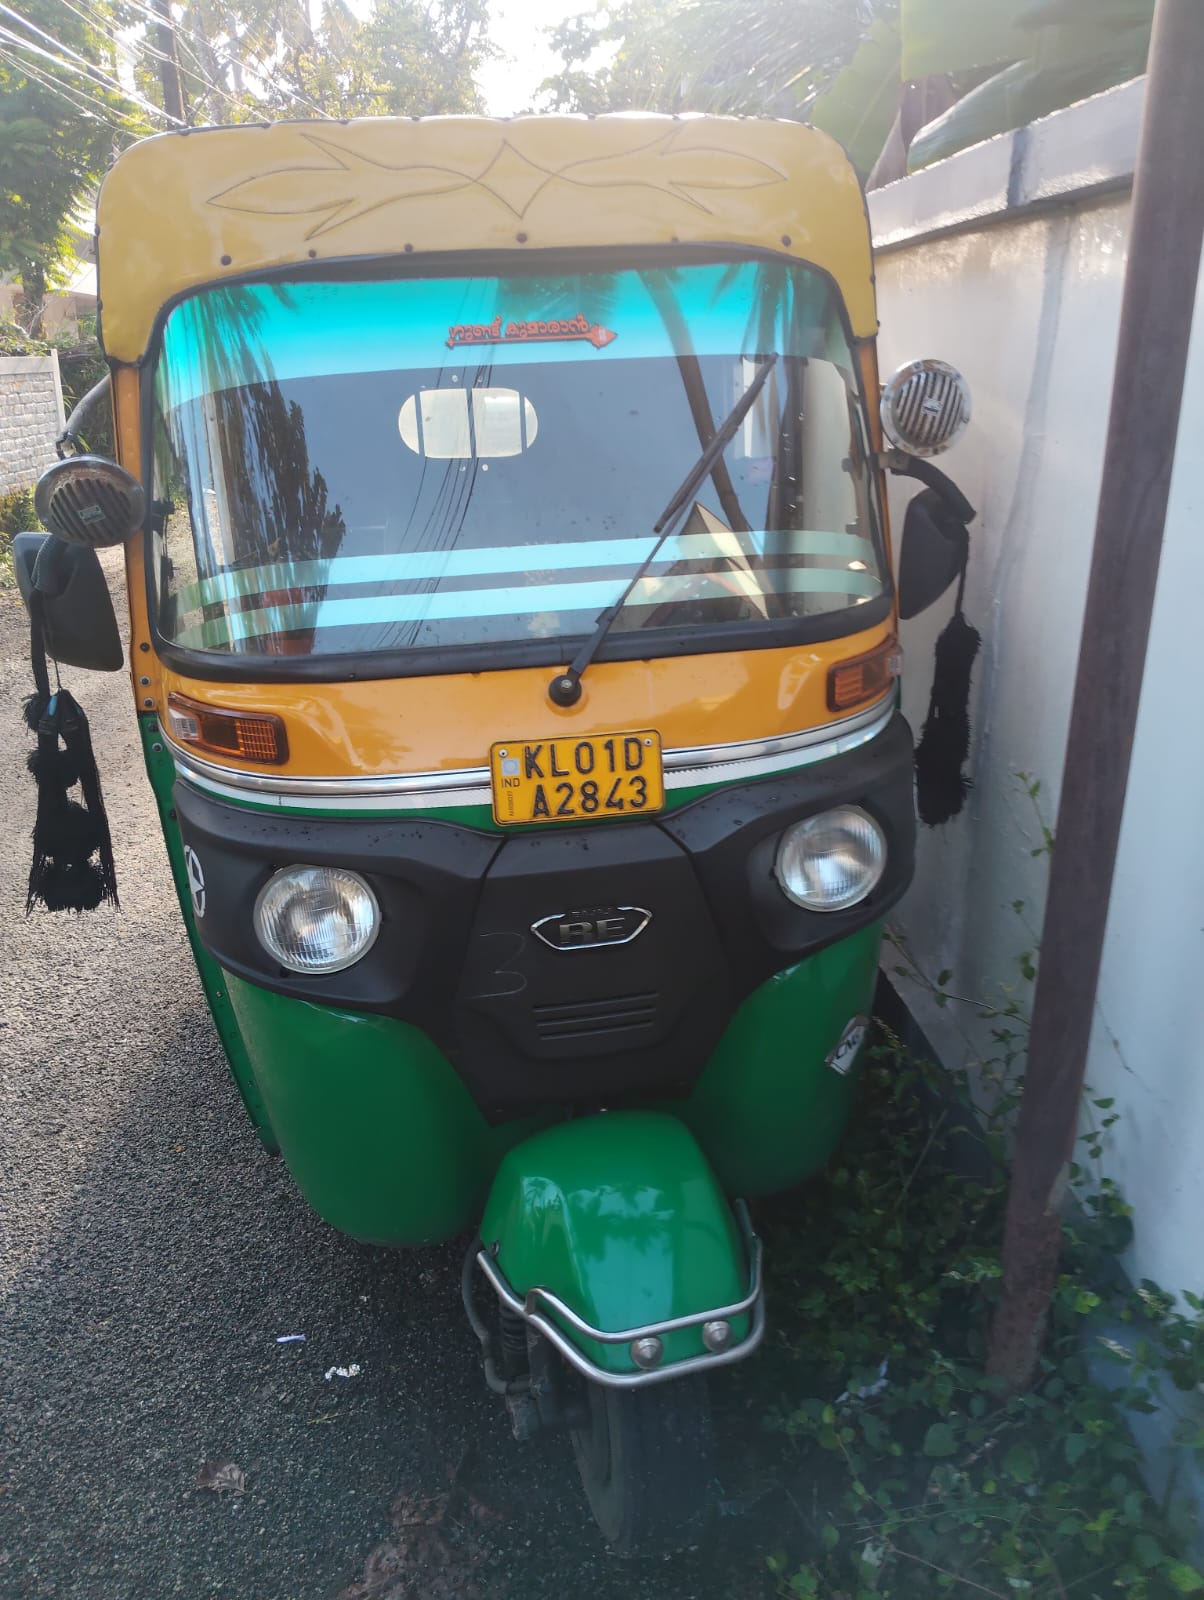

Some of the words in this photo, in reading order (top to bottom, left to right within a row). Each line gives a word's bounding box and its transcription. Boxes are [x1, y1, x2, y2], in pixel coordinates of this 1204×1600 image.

[525, 737, 643, 779] KL01D
[501, 777, 521, 789] IND
[533, 775, 647, 818] A2843
[559, 917, 626, 944] RE
